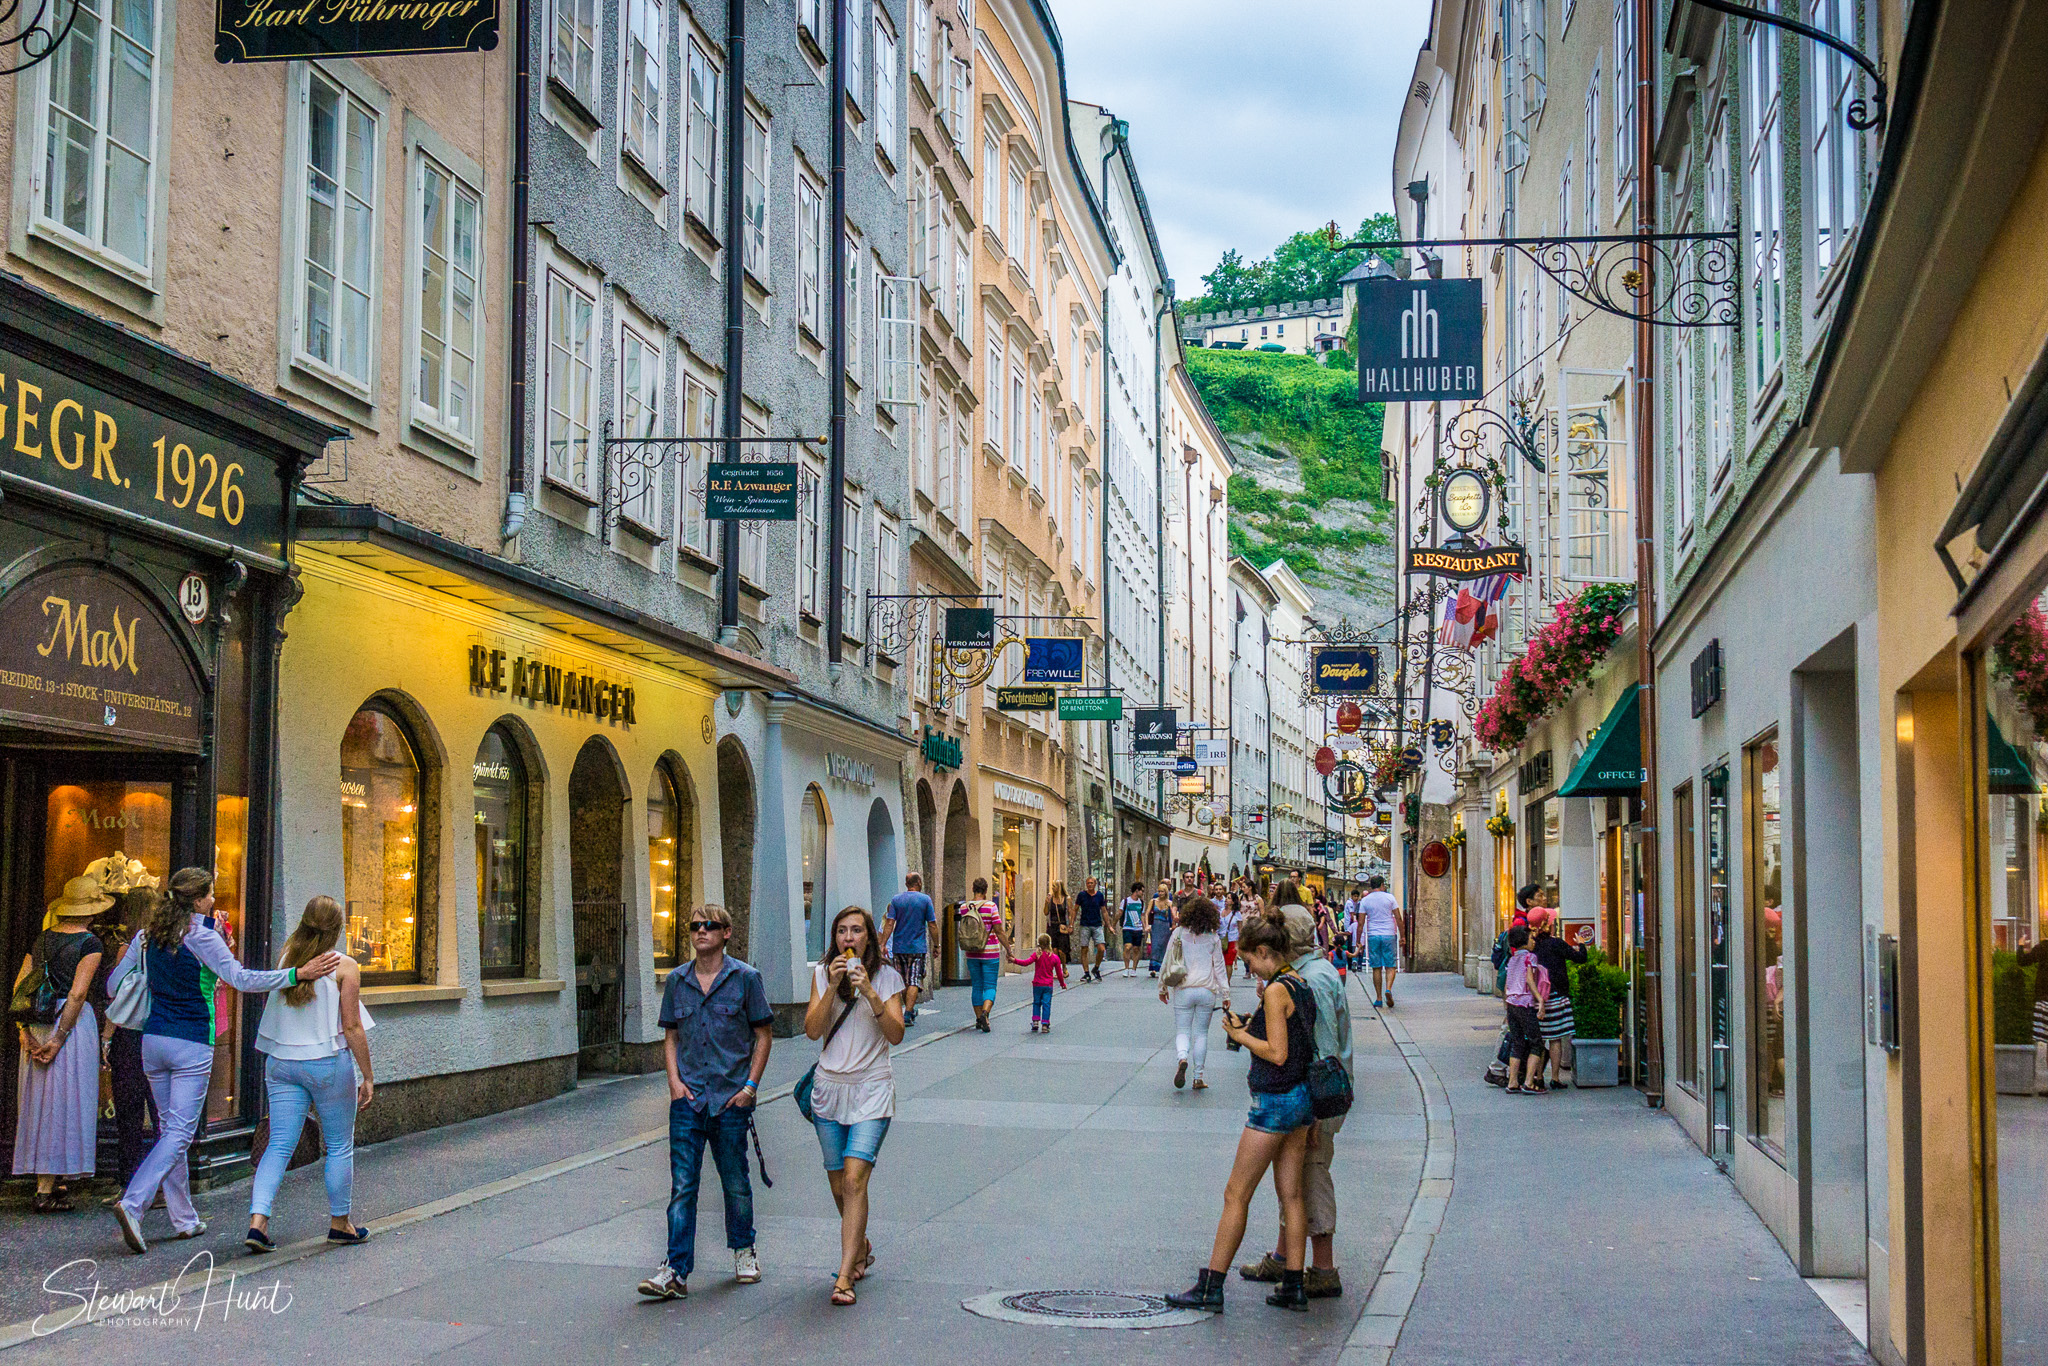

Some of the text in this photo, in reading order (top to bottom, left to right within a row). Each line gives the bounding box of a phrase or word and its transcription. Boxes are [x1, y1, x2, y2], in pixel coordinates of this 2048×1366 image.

[234, 0, 479, 30] Karl Pühringer
[1366, 366, 1476, 392] HALLHUBER
[0, 373, 245, 526] EGR. 1926
[721, 469, 759, 477] Gegründet
[734, 480, 793, 493] Azwanger
[713, 495, 735, 504] Wein
[744, 495, 788, 505] Spirituosen
[1447, 492, 1482, 503] Spaghetti
[723, 505, 775, 514] Delikatessen
[1413, 552, 1520, 572] RESTAURANT
[186, 577, 202, 606] 13
[36, 596, 141, 675] Madl
[1026, 669, 1080, 678] FREYWILLE
[1320, 663, 1368, 681] Douglas
[512, 656, 637, 725] AZWANGER
[1209, 751, 1227, 759] IRB
[1598, 771, 1636, 779] OFFICE
[67, 807, 141, 830] Madl
